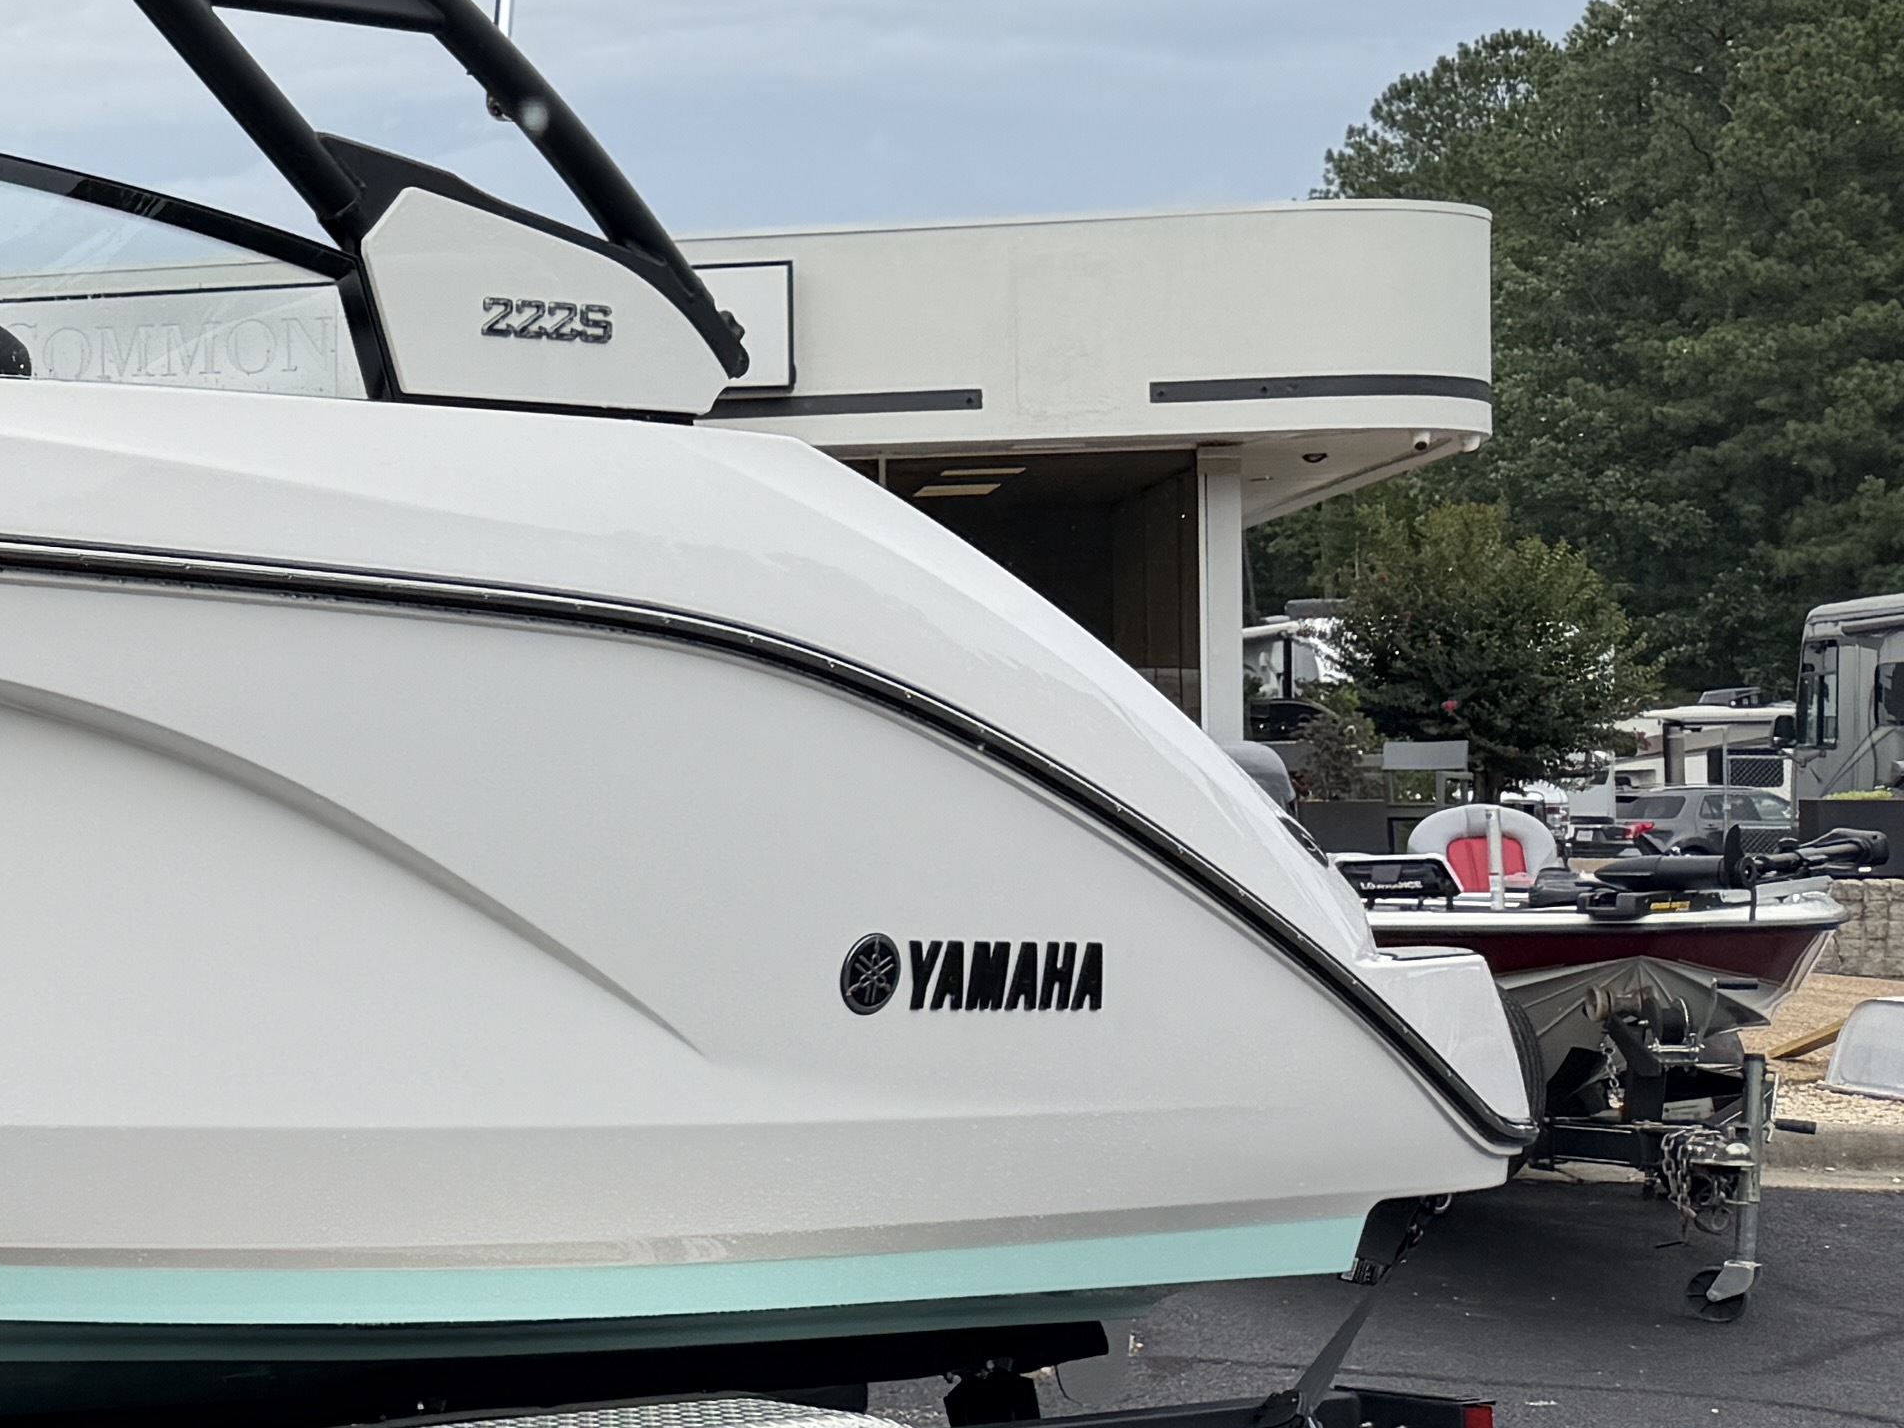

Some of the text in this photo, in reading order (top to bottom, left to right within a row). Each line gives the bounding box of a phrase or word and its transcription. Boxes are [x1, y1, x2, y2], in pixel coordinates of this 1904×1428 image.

[6, 316, 334, 379] OMMON
[481, 296, 613, 344] 222S
[909, 940, 1103, 1011] YAMAHA
